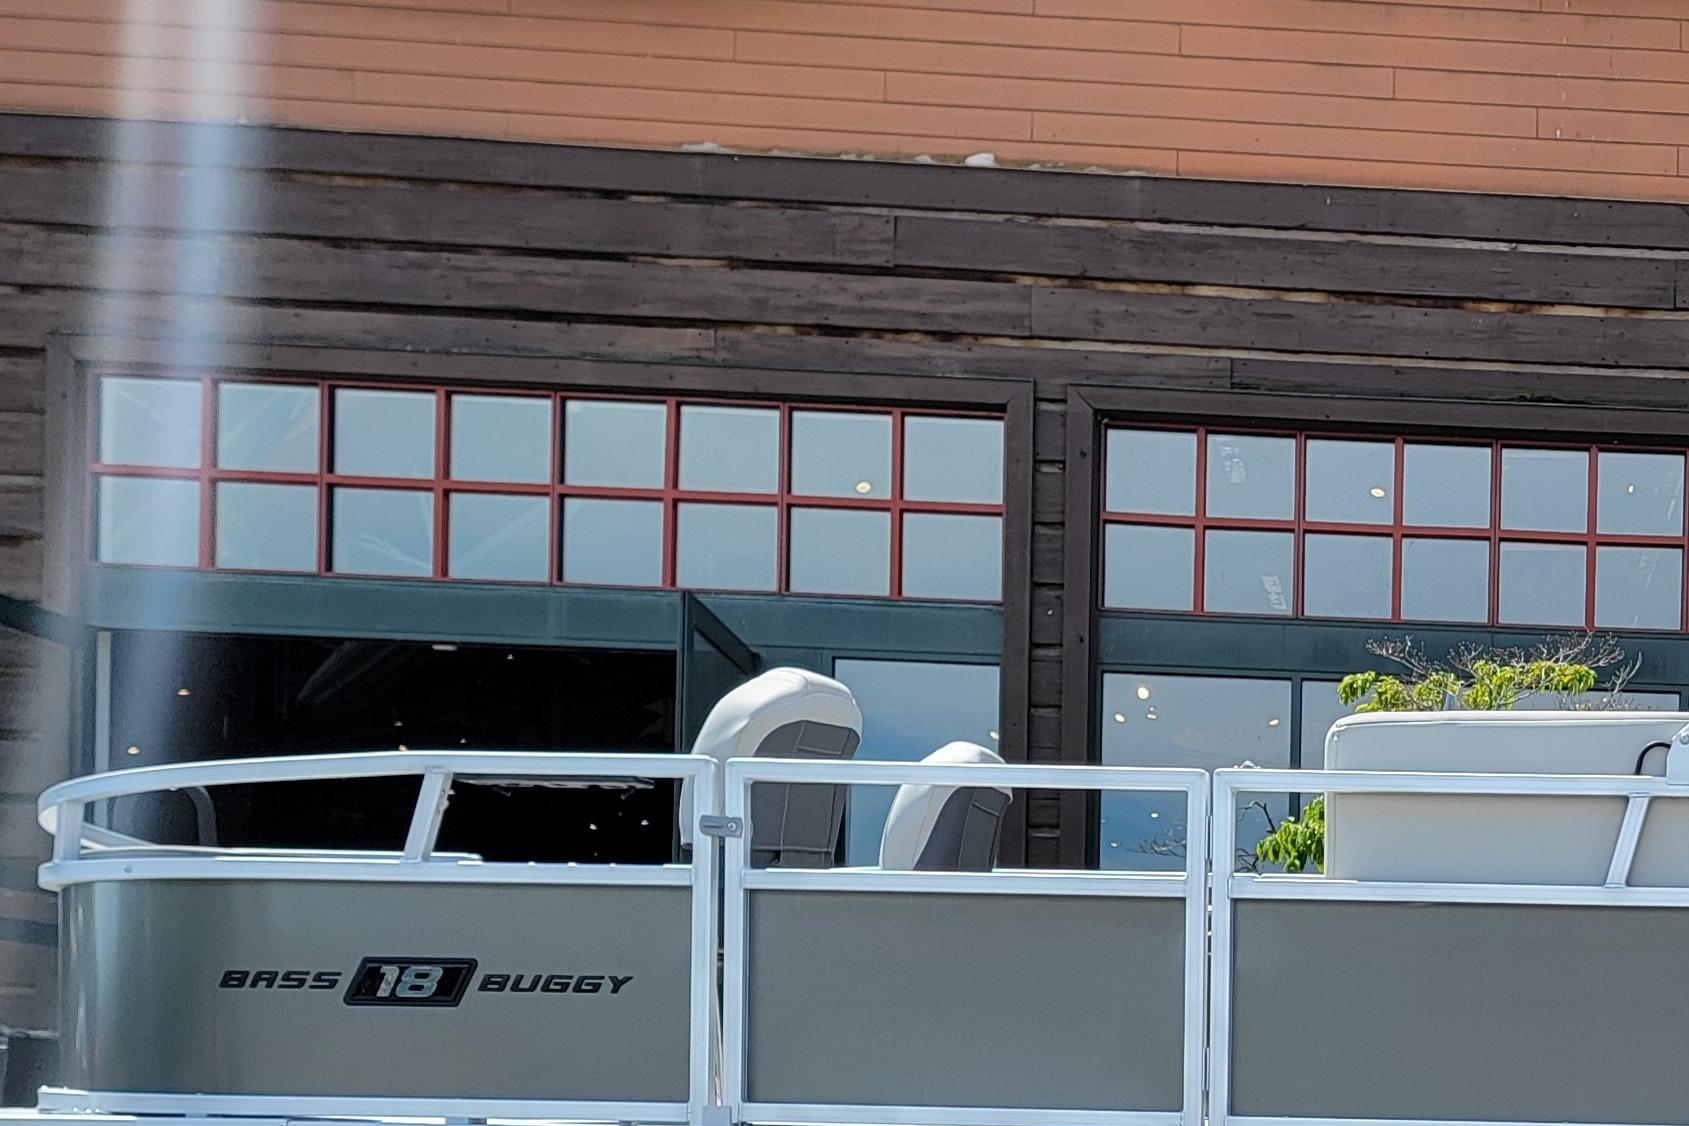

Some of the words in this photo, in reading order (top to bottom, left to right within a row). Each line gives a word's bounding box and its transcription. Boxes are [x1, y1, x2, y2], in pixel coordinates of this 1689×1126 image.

[219, 970, 343, 989] BASS
[375, 965, 443, 998] 18
[476, 973, 634, 994] BUGGY
